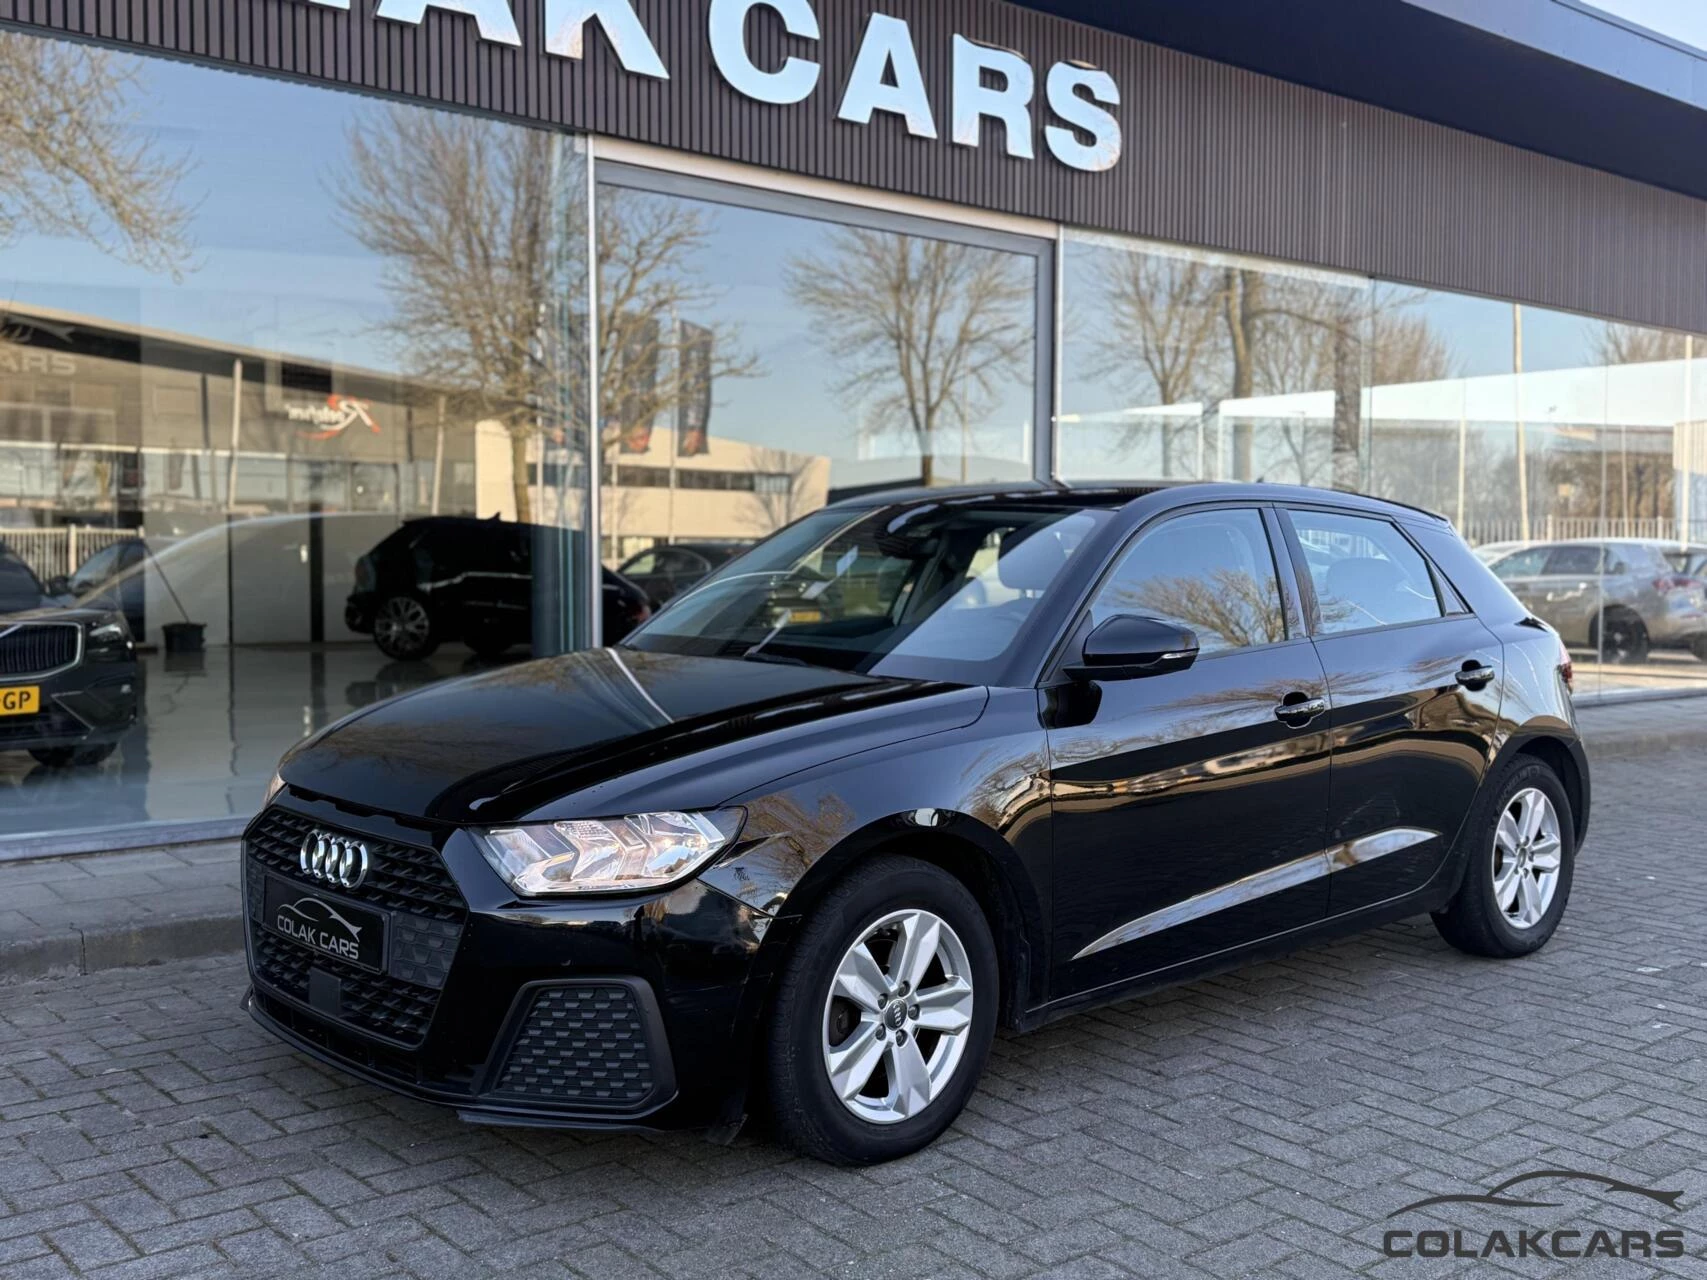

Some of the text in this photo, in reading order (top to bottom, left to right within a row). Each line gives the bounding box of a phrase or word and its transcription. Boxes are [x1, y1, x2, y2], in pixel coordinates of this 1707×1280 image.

[708, 0, 1121, 172] CARS
[277, 915, 359, 960] COLAK CARS
